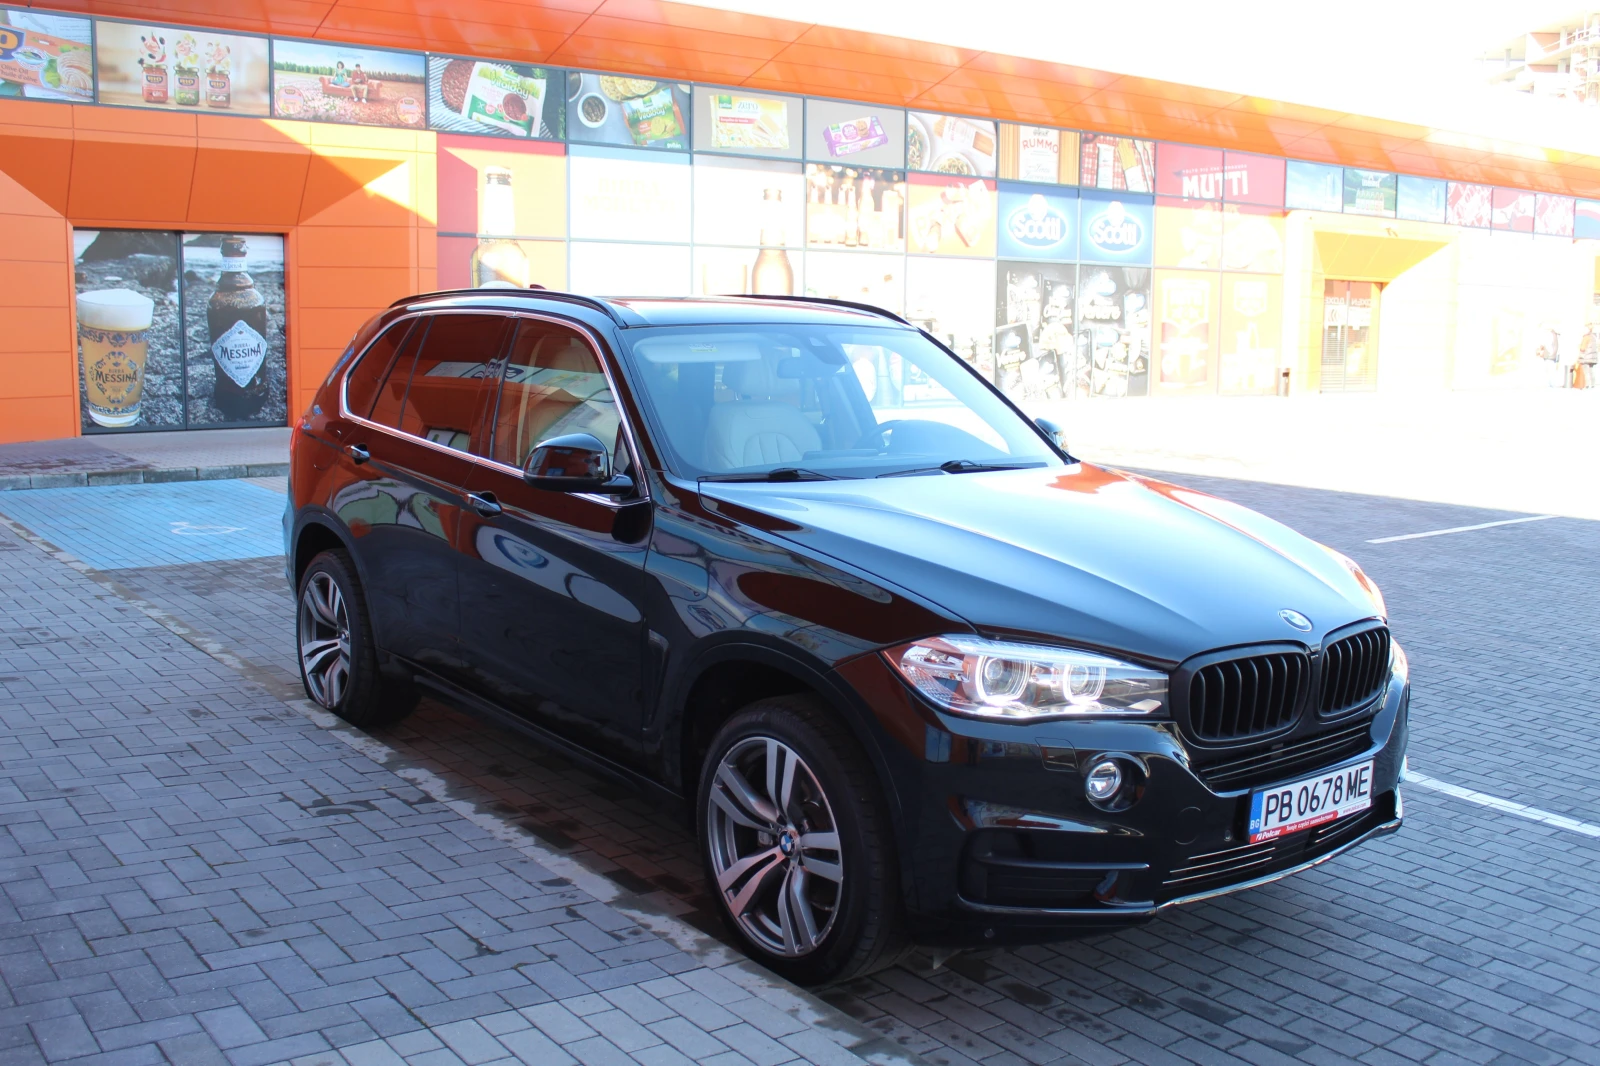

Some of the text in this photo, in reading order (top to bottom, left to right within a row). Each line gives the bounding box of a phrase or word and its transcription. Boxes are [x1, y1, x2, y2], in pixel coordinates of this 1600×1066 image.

[1022, 138, 1060, 154] RUMMO
[1182, 170, 1249, 202] MUTTI
[219, 341, 262, 361] MESSINA
[94, 368, 138, 384] MESSINA
[1264, 765, 1371, 827] PB 0678 ME
[1250, 819, 1261, 830] BG
[1262, 828, 1282, 840] Polcar
